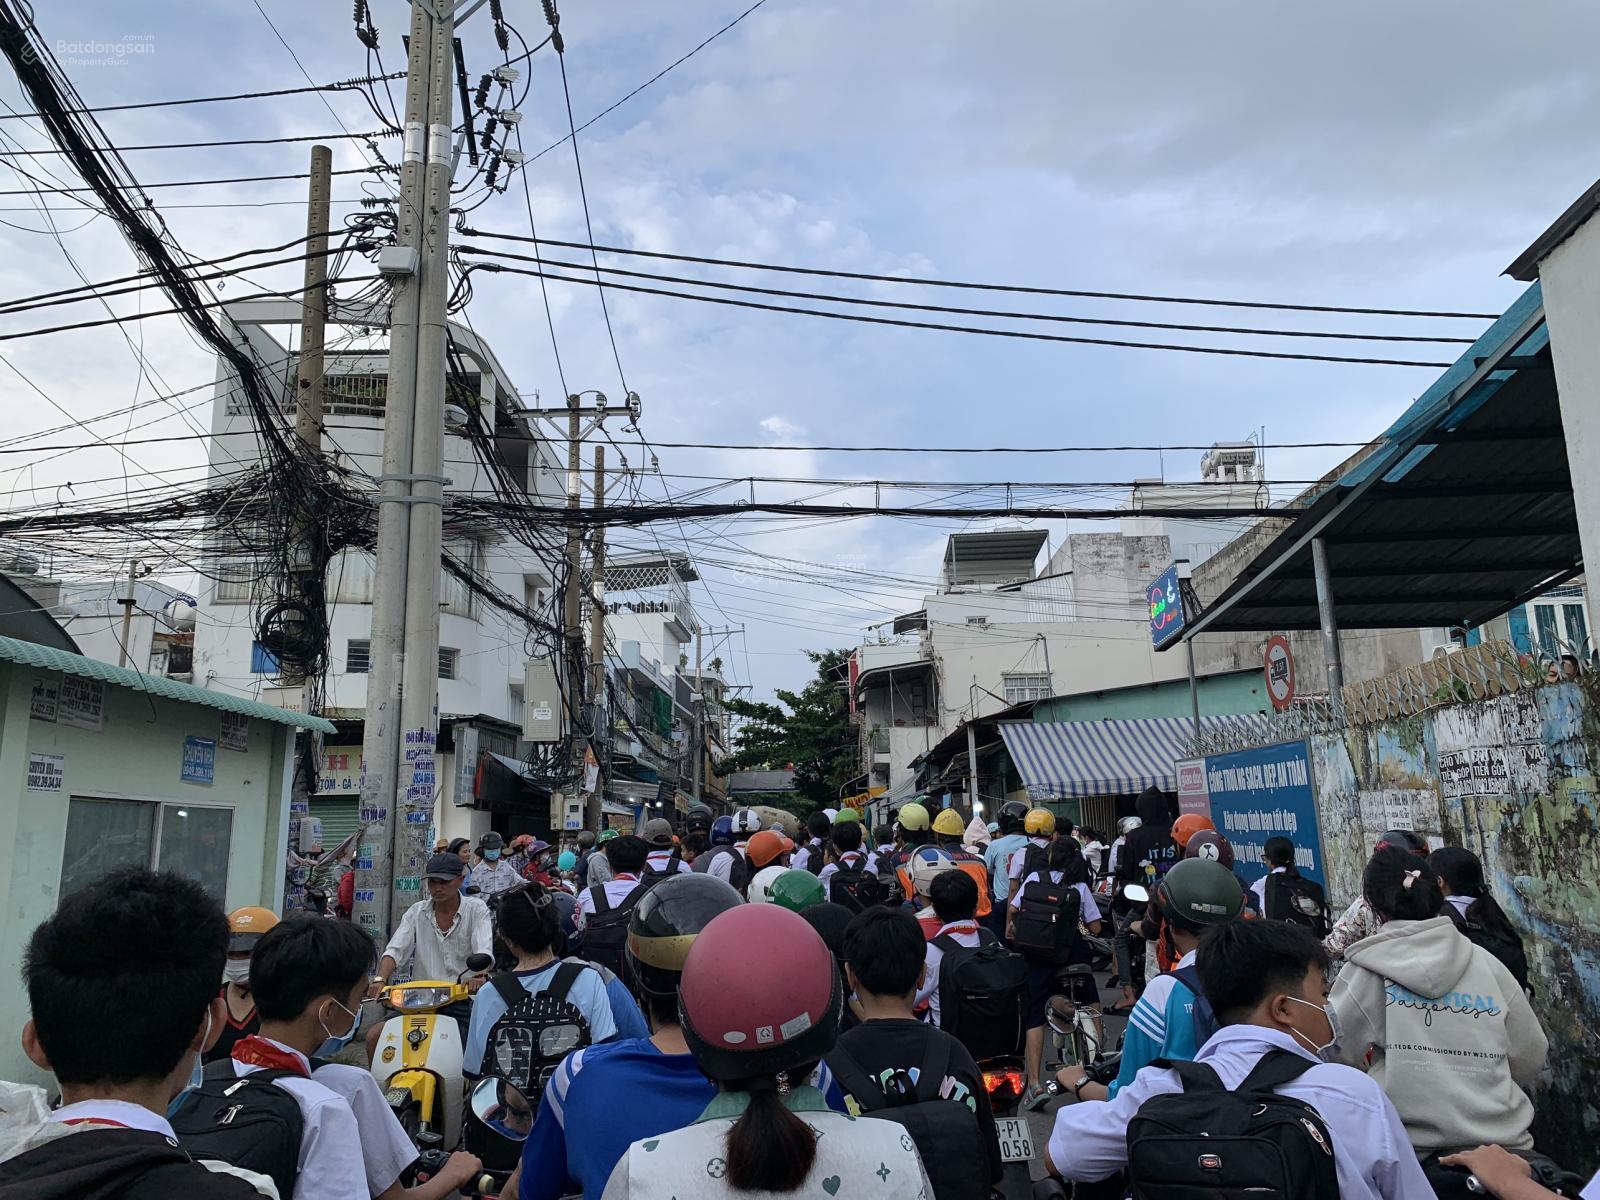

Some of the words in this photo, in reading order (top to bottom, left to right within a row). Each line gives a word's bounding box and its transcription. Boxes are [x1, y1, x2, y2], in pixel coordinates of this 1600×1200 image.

[1439, 755, 1454, 769] CHO
[1208, 765, 1224, 793] CỔNG
[1277, 762, 1288, 787] AN
[1287, 755, 1308, 787] TOÀN
[1148, 848, 1159, 860] IT
[1413, 1044, 1462, 1056] COMMISSIONED
